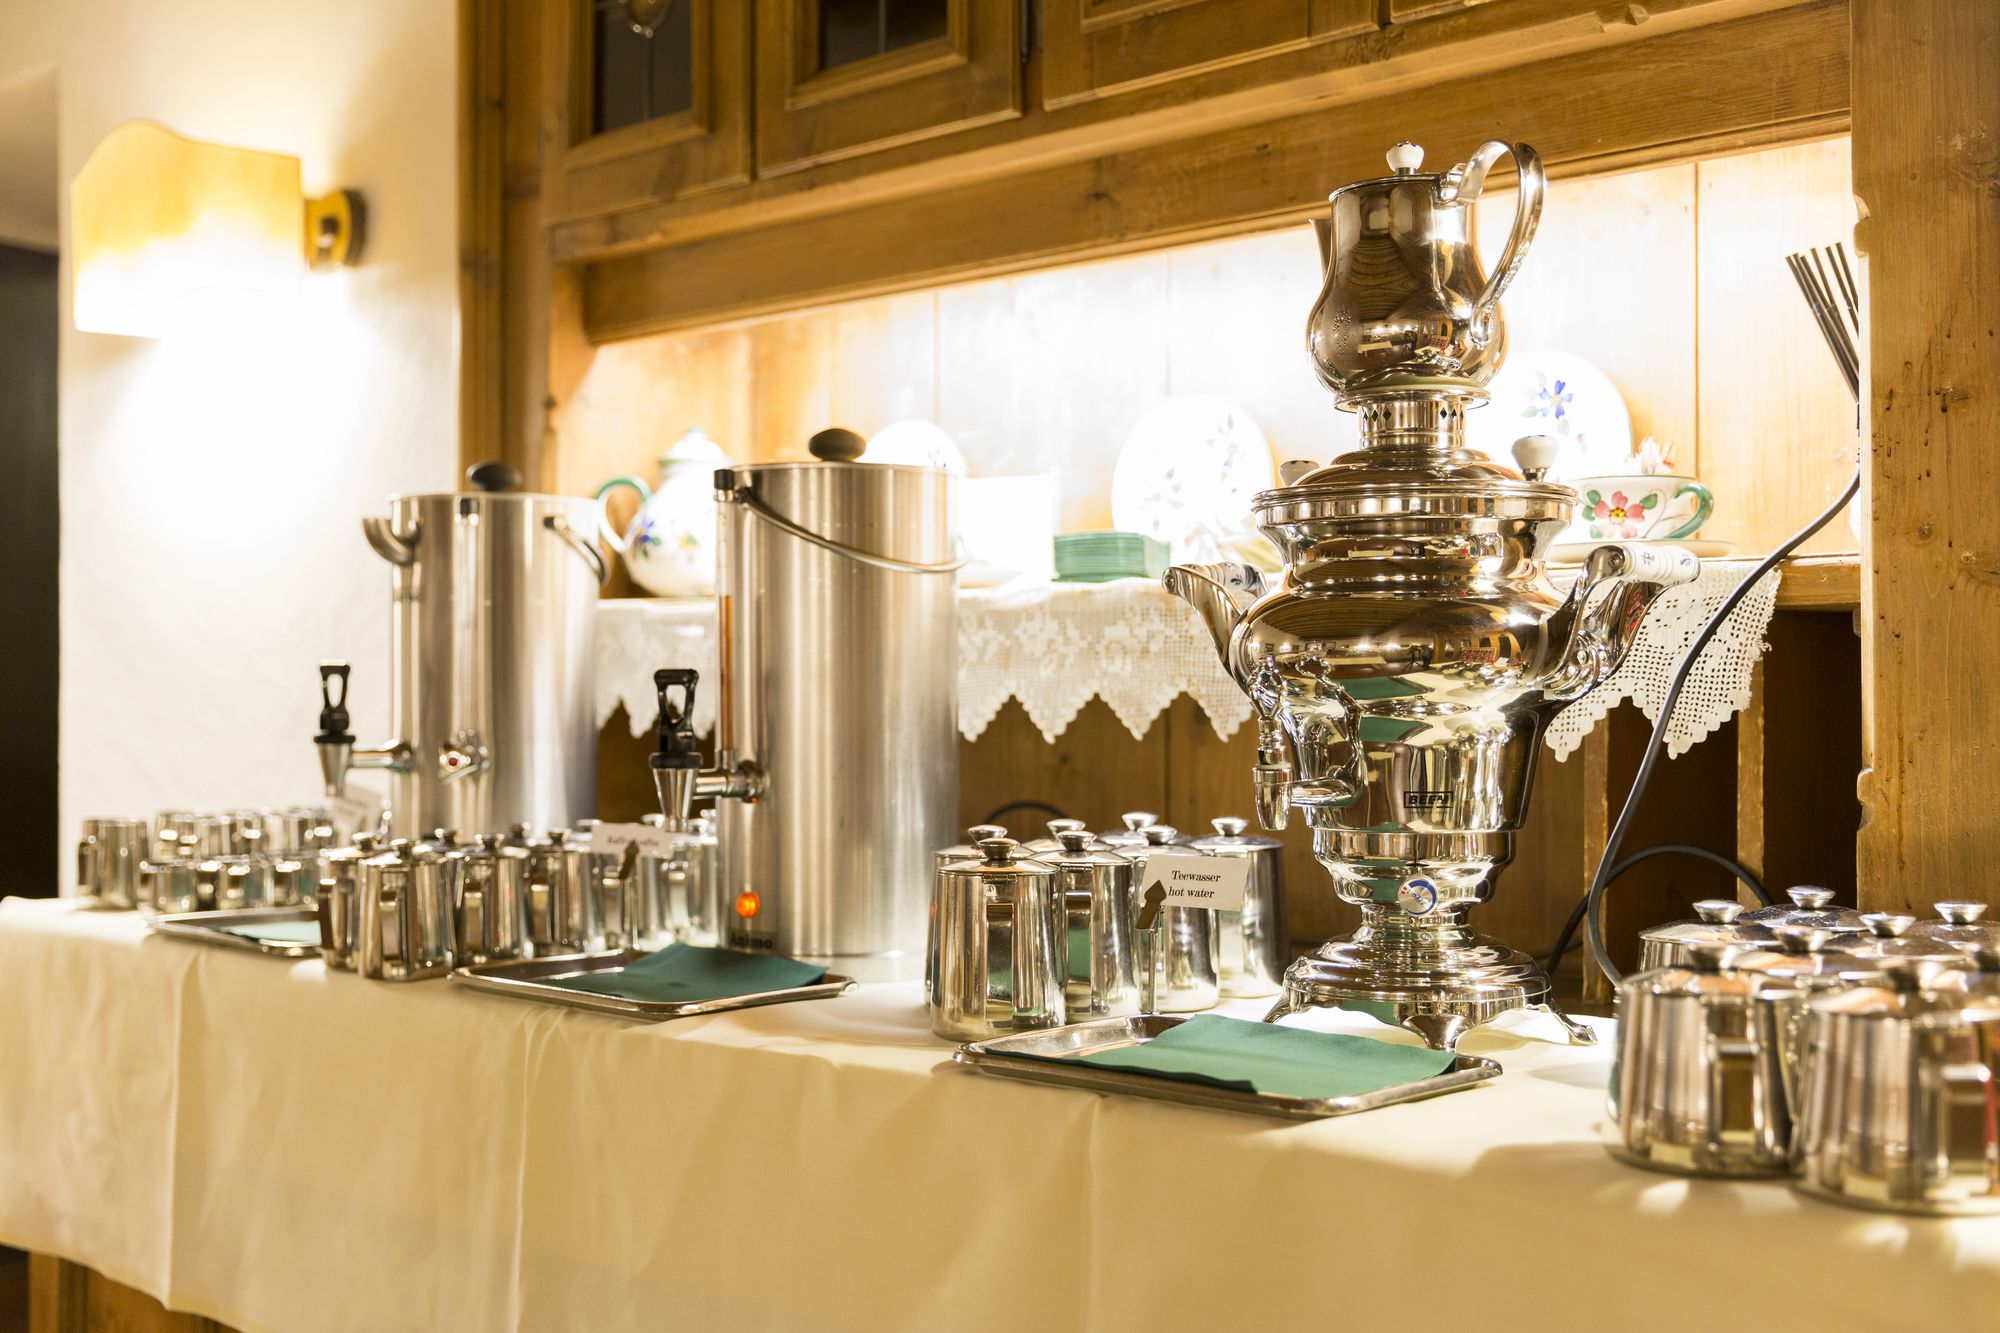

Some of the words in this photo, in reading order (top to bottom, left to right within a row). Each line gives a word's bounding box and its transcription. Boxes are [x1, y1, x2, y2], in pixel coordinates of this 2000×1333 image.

[1171, 870, 1221, 882] Teewasser
[1168, 886, 1184, 897] hot
[1187, 889, 1215, 898] water
